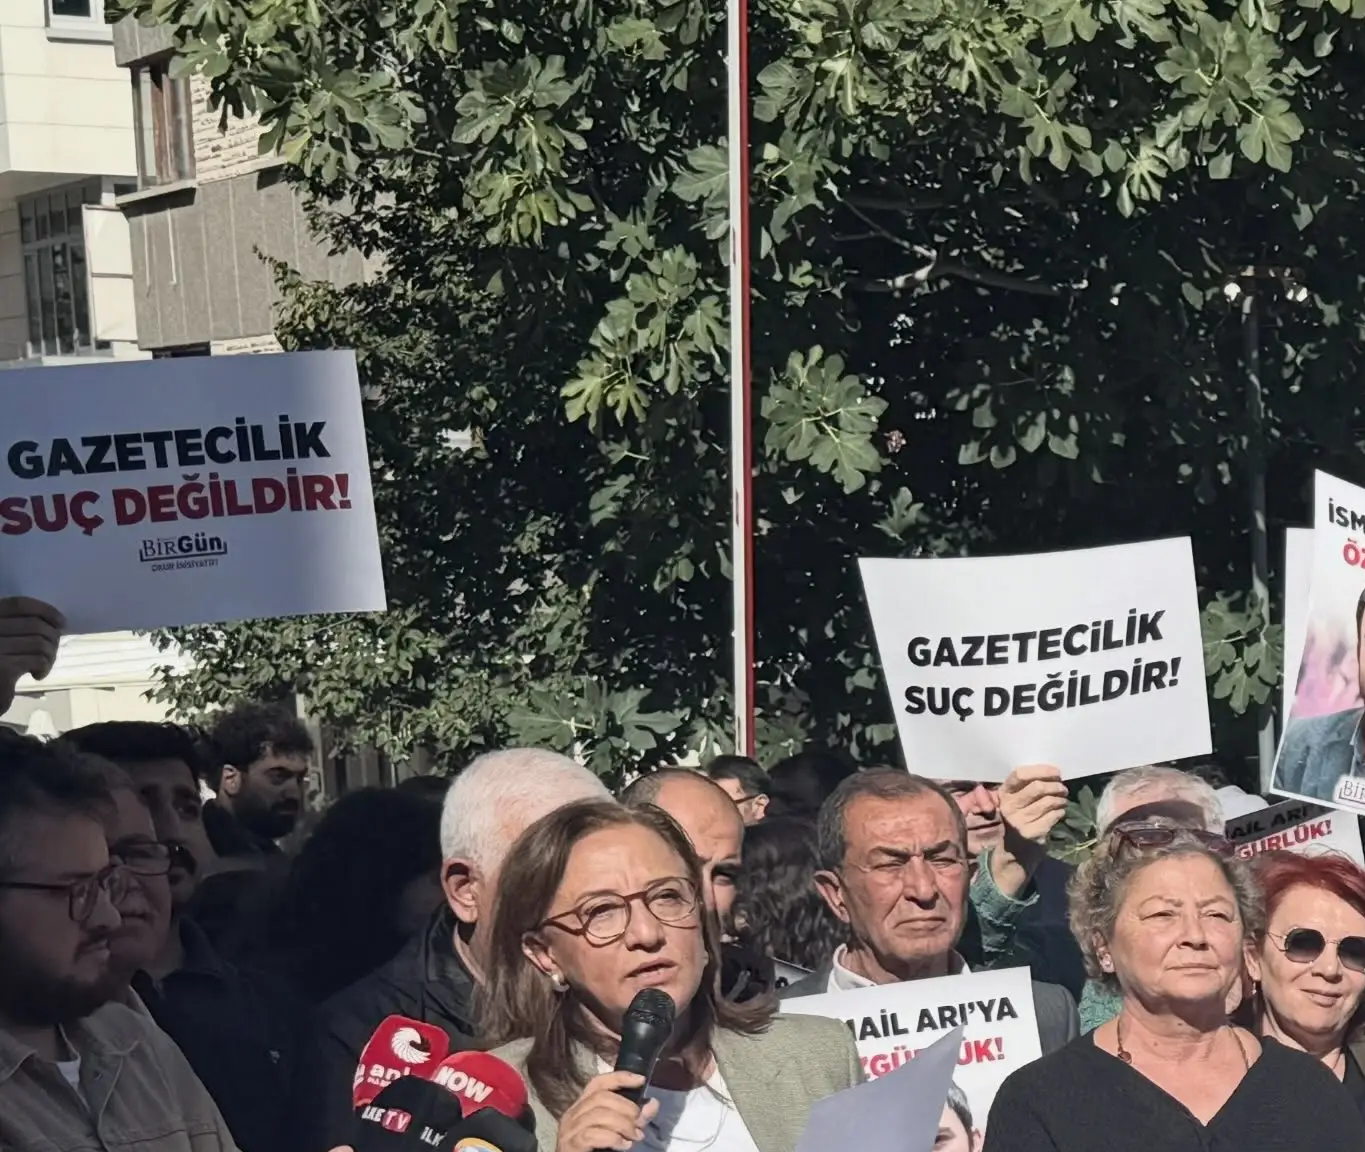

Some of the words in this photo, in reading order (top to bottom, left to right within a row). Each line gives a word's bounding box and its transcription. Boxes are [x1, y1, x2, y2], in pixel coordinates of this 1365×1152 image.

[7, 414, 331, 479] GAZETECİLİK
[0, 491, 105, 536] SUÇ
[112, 467, 353, 527] DEĞİLDİR!
[904, 686, 974, 722] SUÇ
[983, 656, 1182, 717] DEĞİLDİR!
[916, 996, 1019, 1032] ARI'YA
[435, 1065, 494, 1103] NOW
